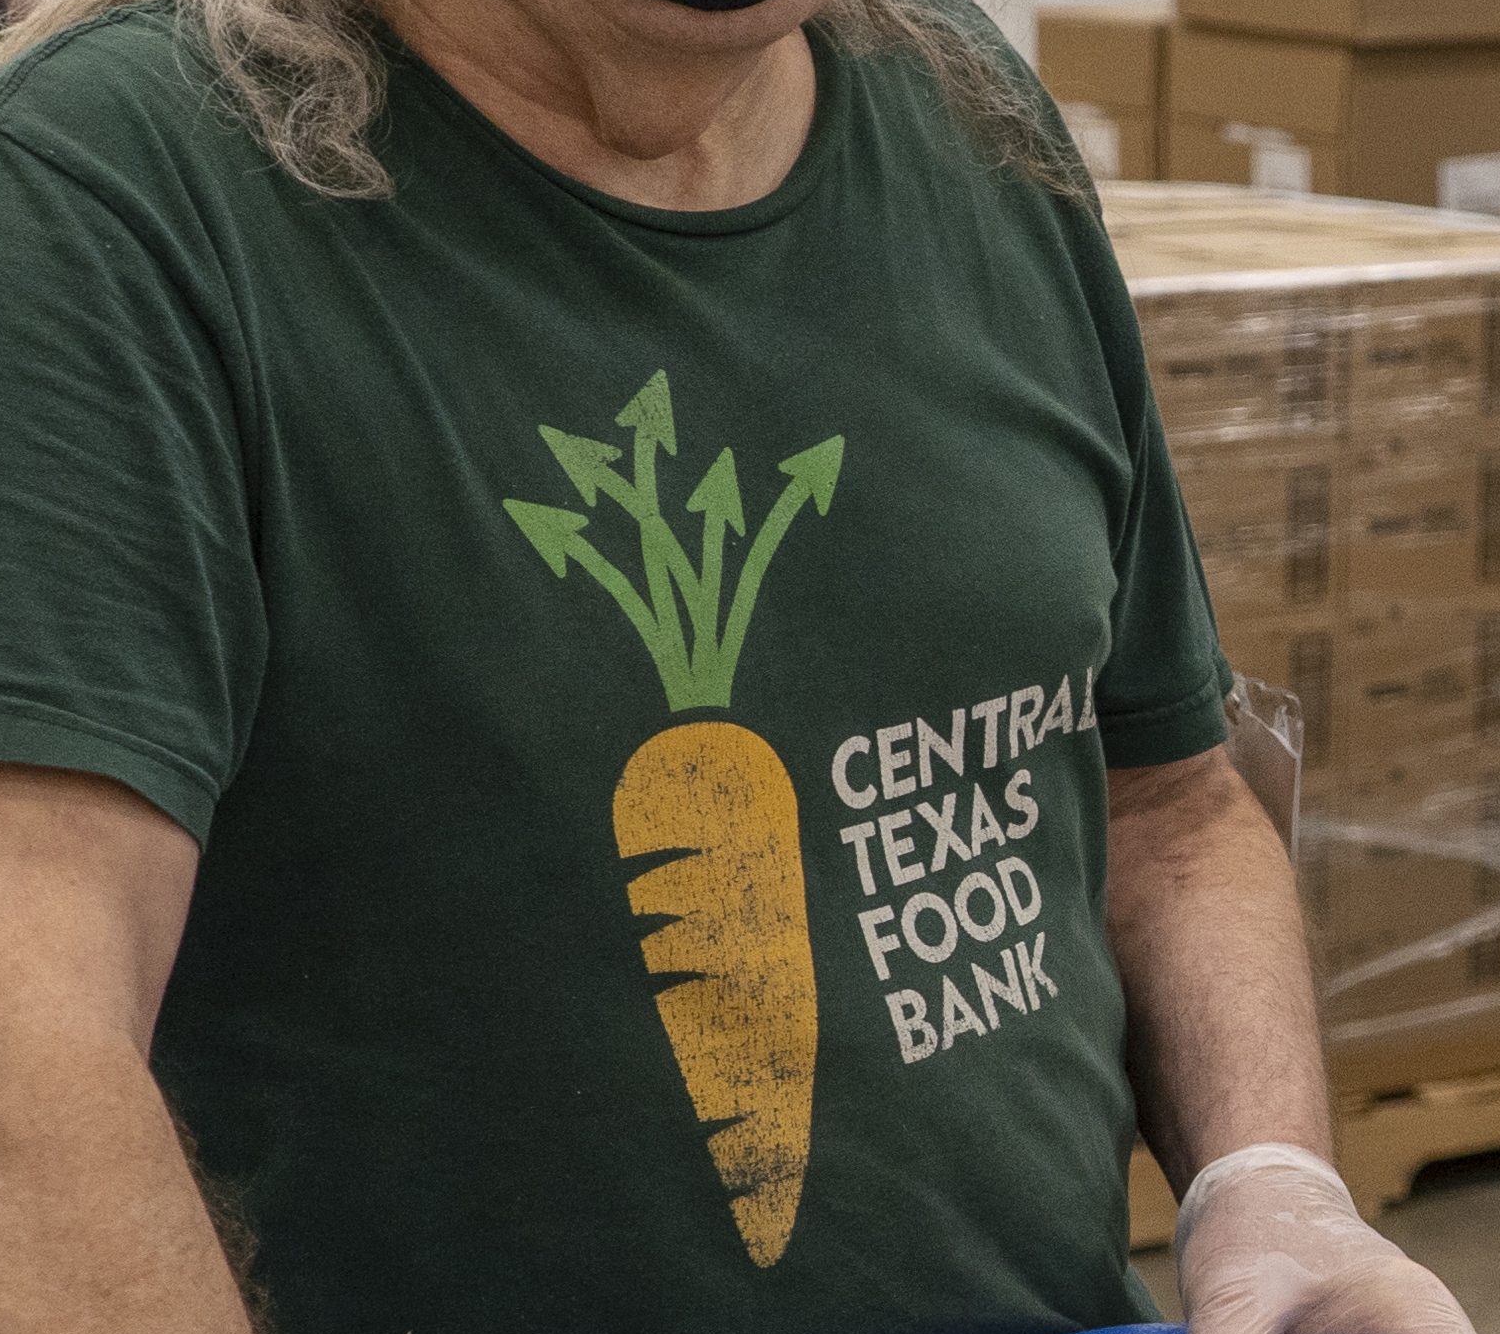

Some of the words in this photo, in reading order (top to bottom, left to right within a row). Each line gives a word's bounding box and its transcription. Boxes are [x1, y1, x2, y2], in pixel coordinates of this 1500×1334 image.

[831, 666, 1097, 810] CENTRAL
[840, 769, 1040, 896] TEXAS
[857, 857, 1042, 981] FOOD
[885, 931, 1058, 1064] BANK
